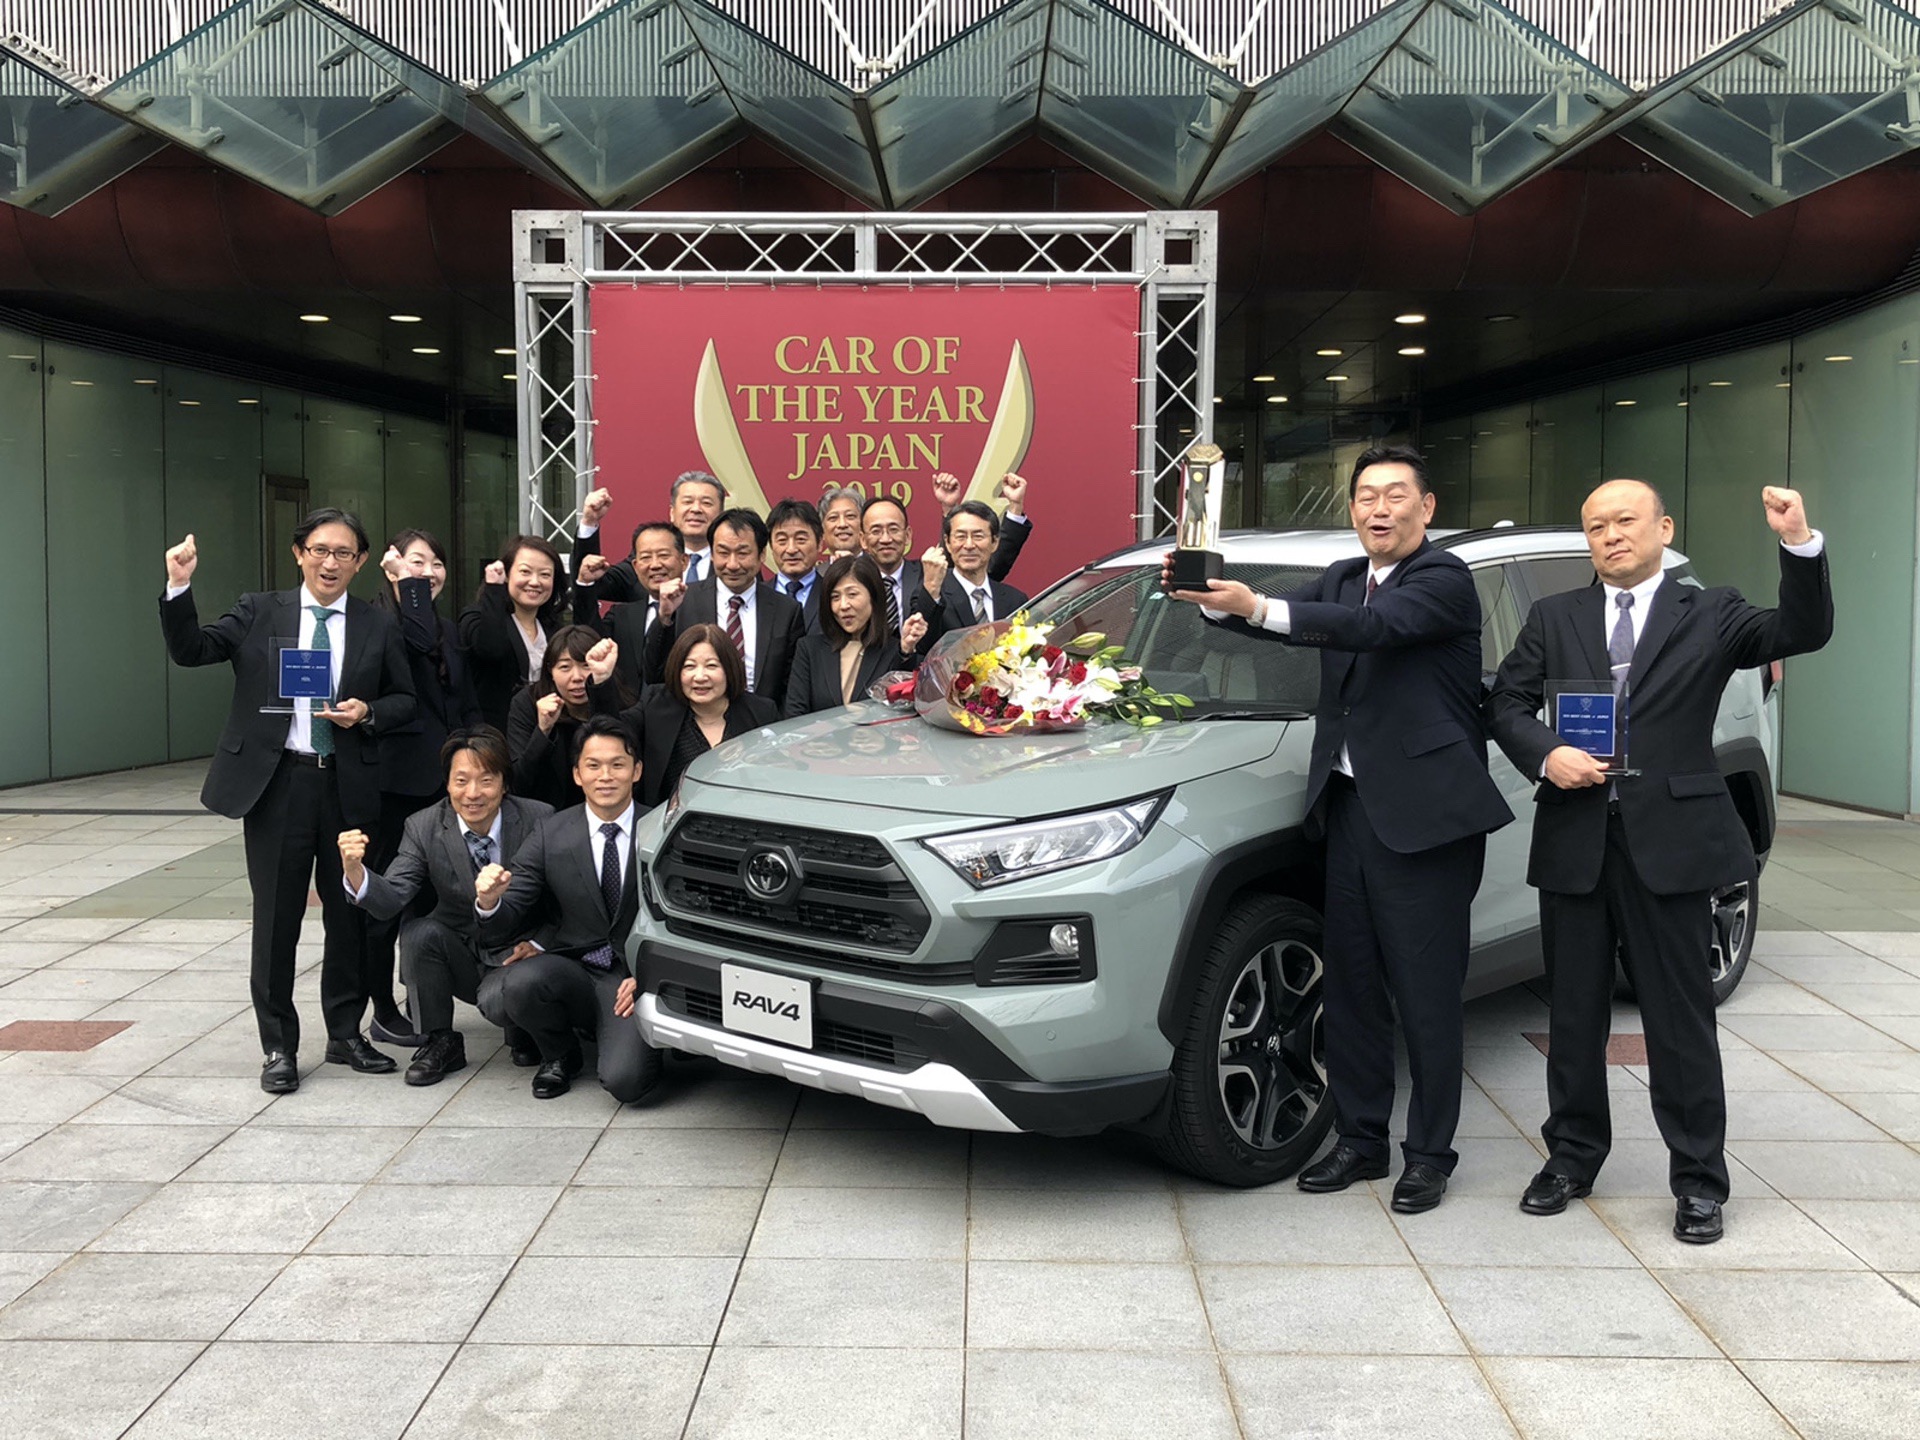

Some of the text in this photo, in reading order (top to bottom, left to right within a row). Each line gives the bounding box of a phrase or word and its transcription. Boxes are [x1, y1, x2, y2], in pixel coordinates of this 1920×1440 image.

[775, 336, 960, 375] CAR OF
[736, 385, 990, 424] THE YEAR
[788, 433, 943, 480] JAPAN
[822, 480, 913, 508] 19
[732, 990, 801, 1022] RAV4
